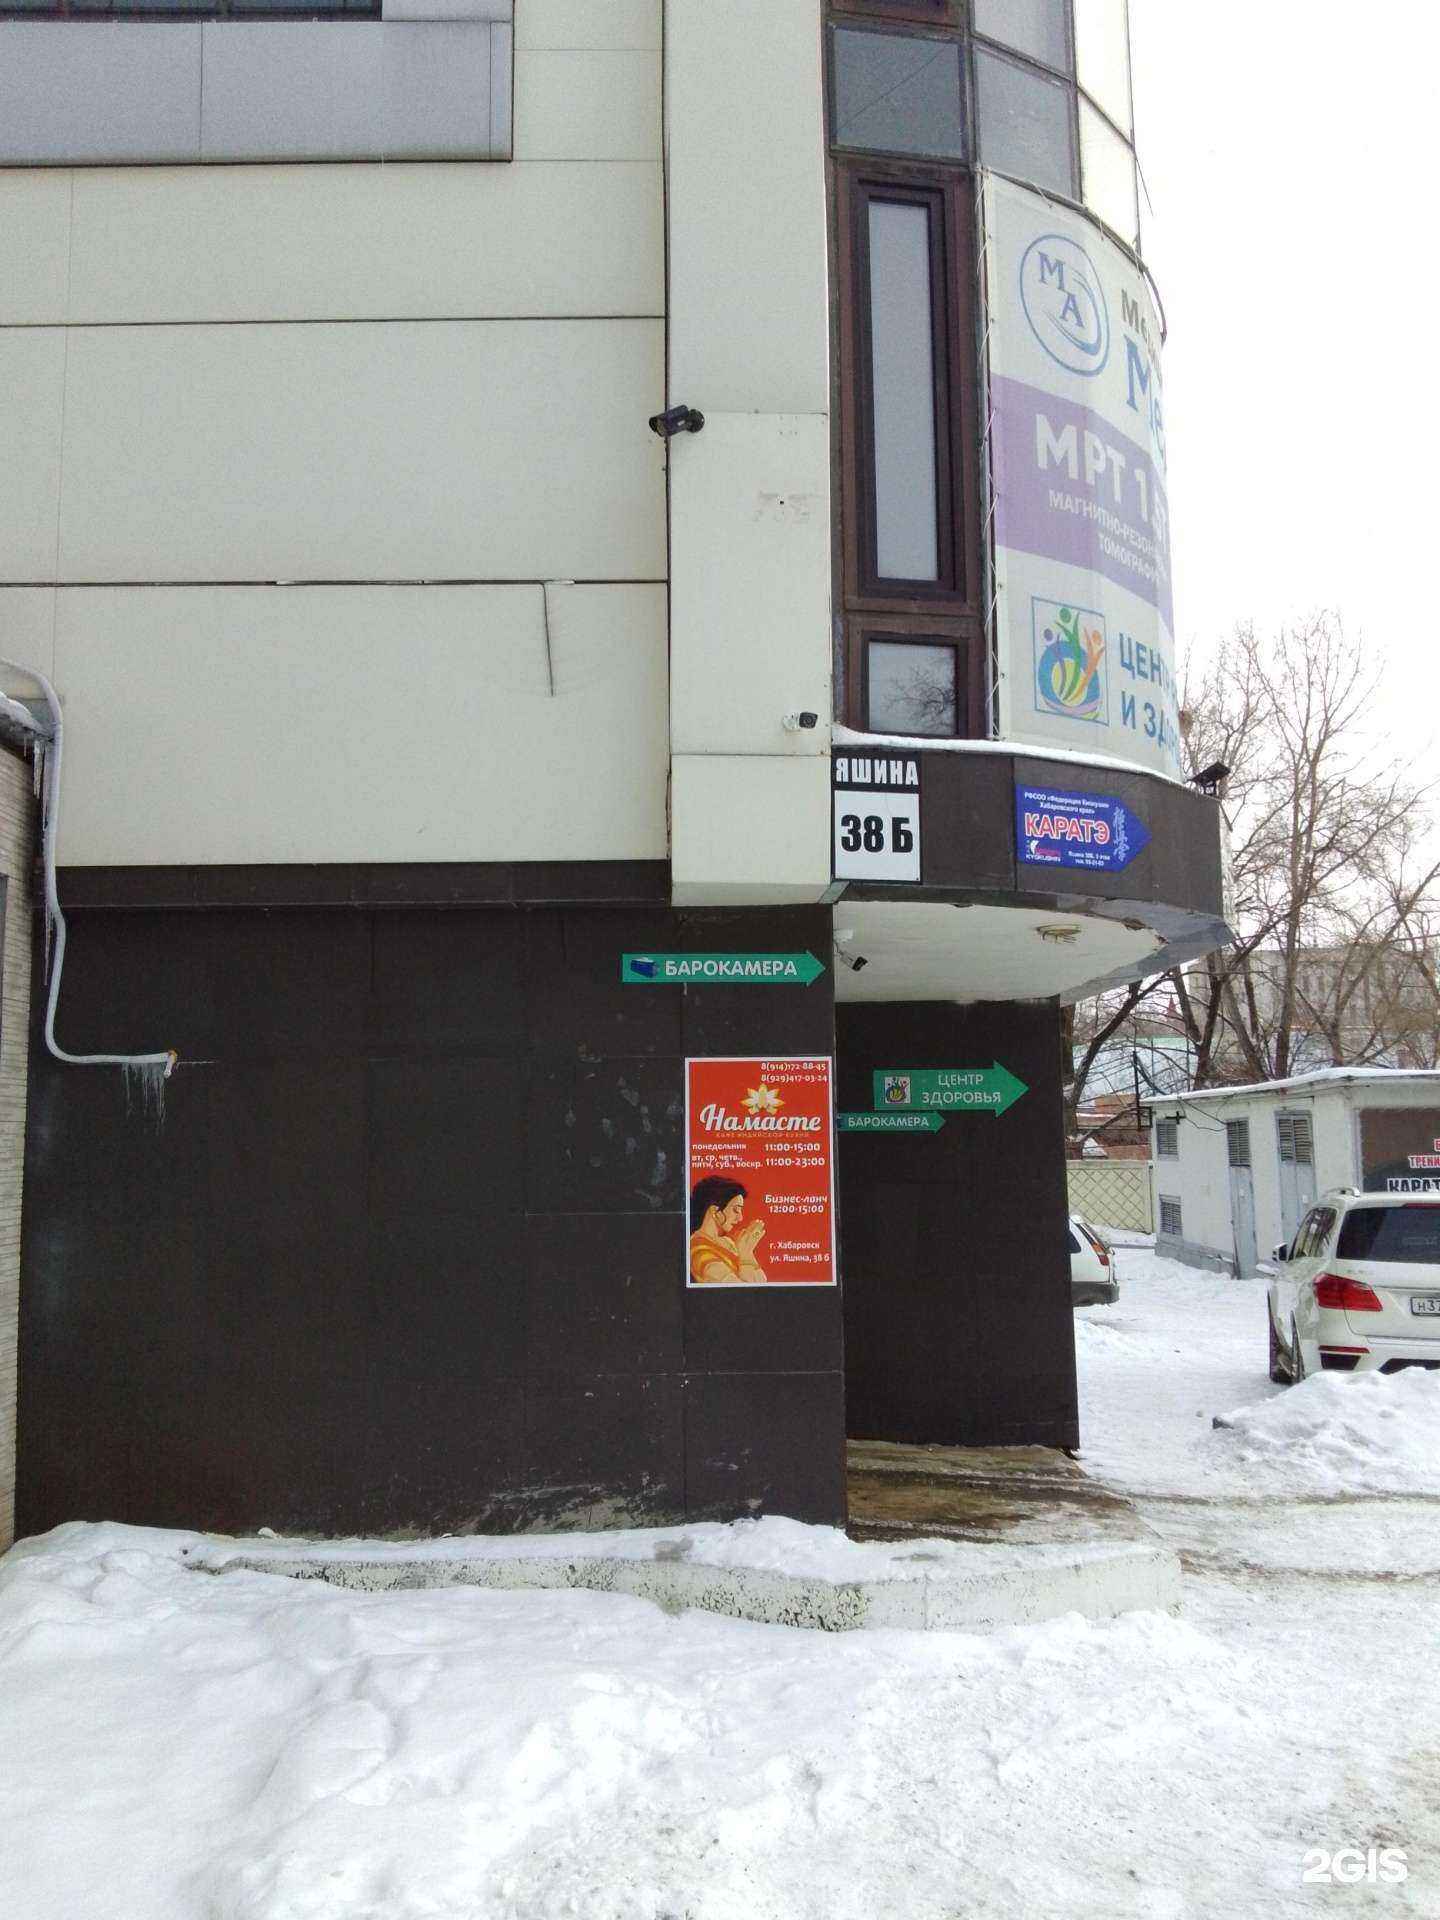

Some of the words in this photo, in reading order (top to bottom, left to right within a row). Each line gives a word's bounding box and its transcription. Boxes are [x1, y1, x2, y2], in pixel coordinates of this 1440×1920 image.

[1036, 414, 1125, 504] МРТ
[1121, 691, 1136, 730] И
[836, 758, 919, 785] ЯШИНА
[841, 815, 884, 852] 38
[892, 817, 913, 853] Б
[1025, 813, 1110, 844] КАРАТЭ
[665, 960, 797, 976] БАРОКАМЕРА
[938, 1074, 984, 1087] ЦЕНТР
[922, 1091, 1001, 1106] ЗДОРОВЬЯ
[700, 1104, 821, 1131] Намасте
[848, 1116, 929, 1127] БАРОКАМЕРА
[765, 1143, 820, 1152] 11:00-15:00
[766, 1158, 825, 1168] 11:00-23:00
[770, 1205, 824, 1215] 12:00-15:00
[777, 1241, 820, 1250] Хабаровск
